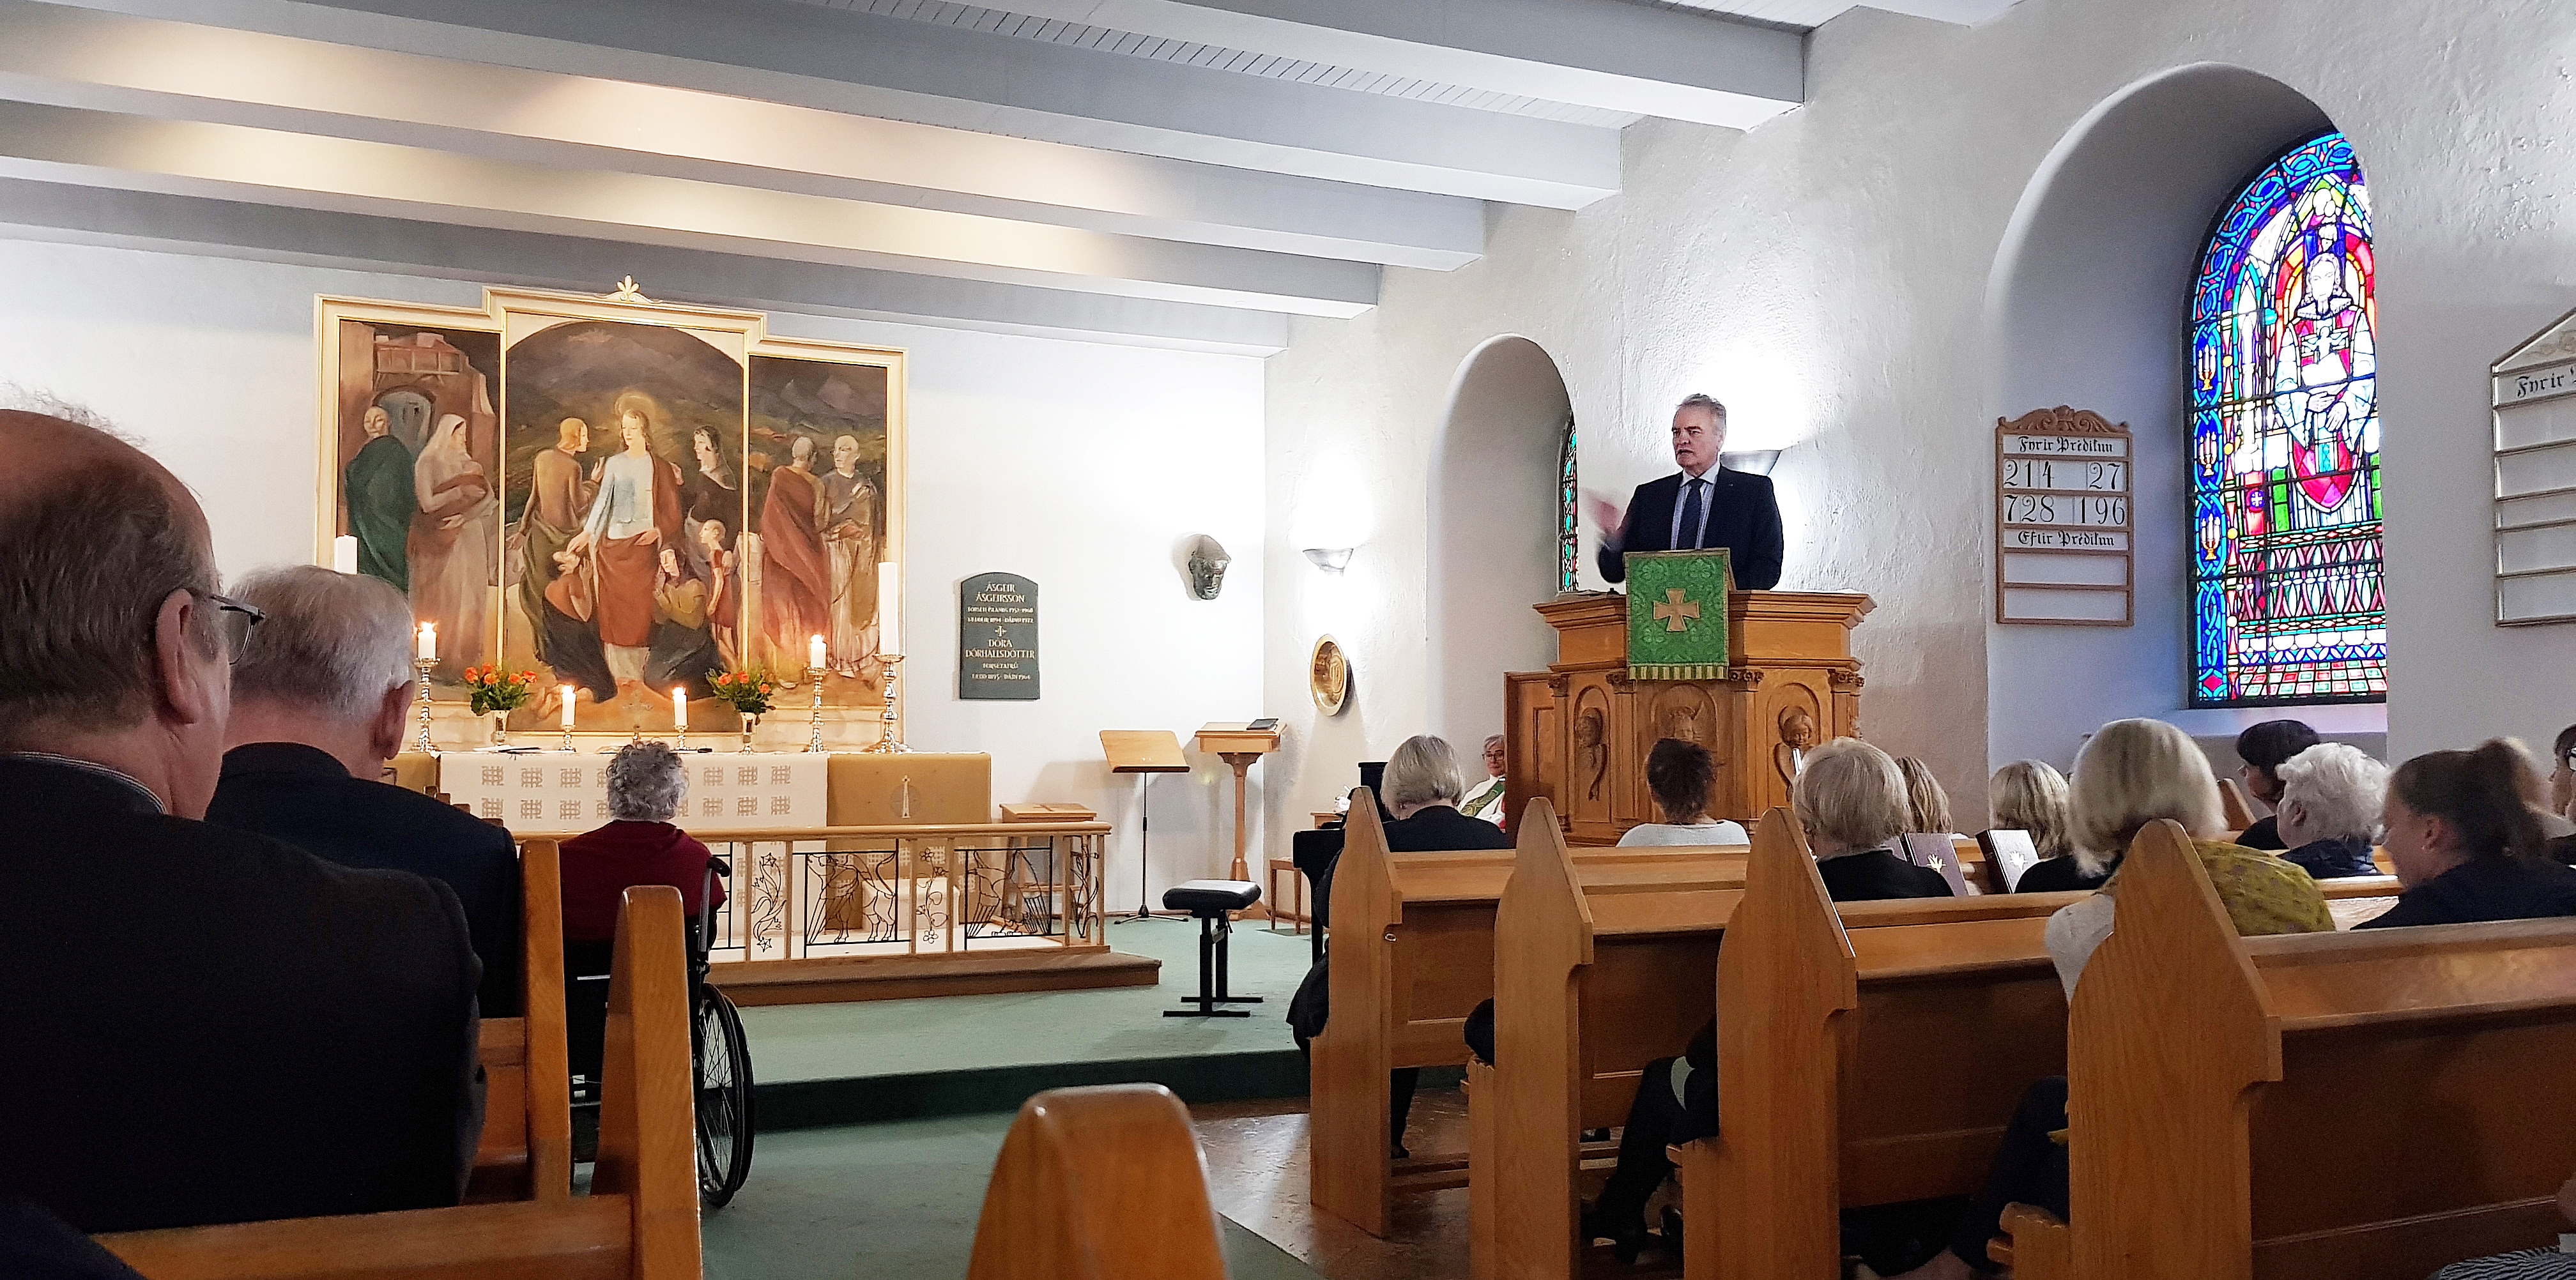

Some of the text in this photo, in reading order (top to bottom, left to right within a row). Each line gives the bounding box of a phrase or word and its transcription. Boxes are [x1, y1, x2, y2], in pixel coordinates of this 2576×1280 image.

[2516, 373, 2564, 397] Fyrir
[2018, 436, 2053, 452] Fyrir
[2004, 460, 2120, 489] 214 27
[2004, 495, 2125, 524] 728 196
[2018, 530, 2053, 546] Eftir
[976, 592, 1025, 602] ÁSGEIRSSON
[988, 637, 1013, 648] DÓRA
